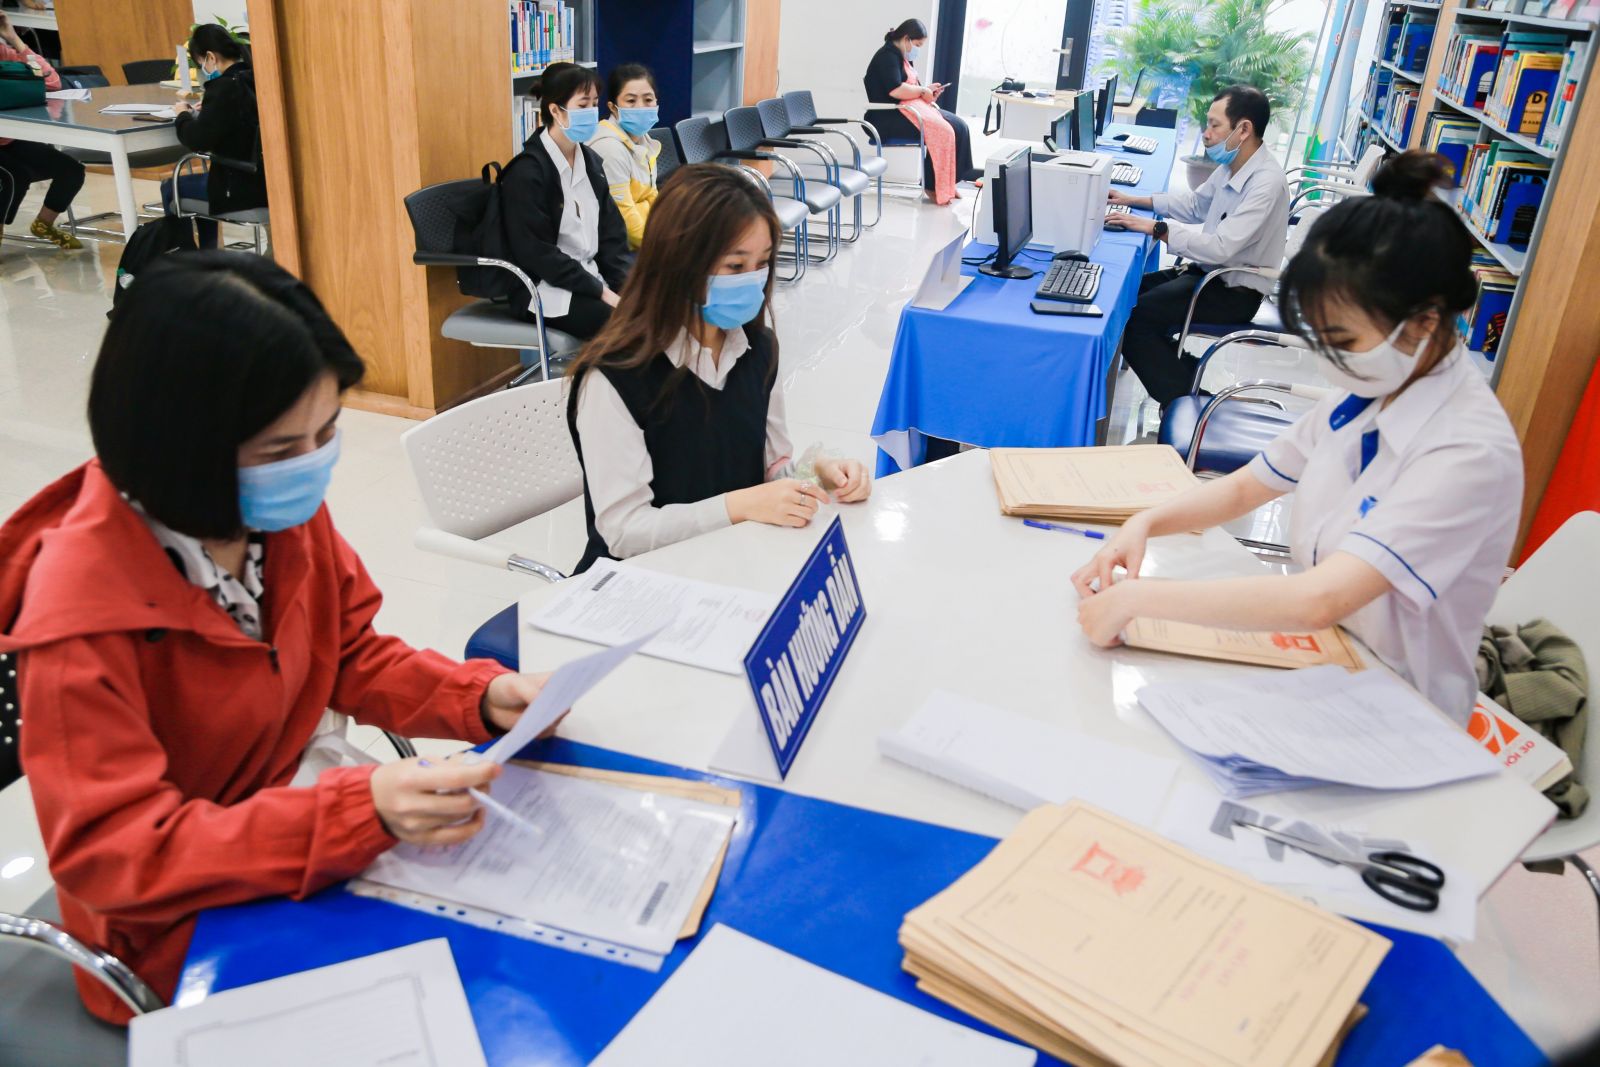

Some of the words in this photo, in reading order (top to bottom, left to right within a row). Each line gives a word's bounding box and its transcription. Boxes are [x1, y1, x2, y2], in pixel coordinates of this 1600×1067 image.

[761, 656, 804, 751] BÀN
[788, 590, 840, 701] HƯỚNG
[826, 543, 860, 635] DẪN
